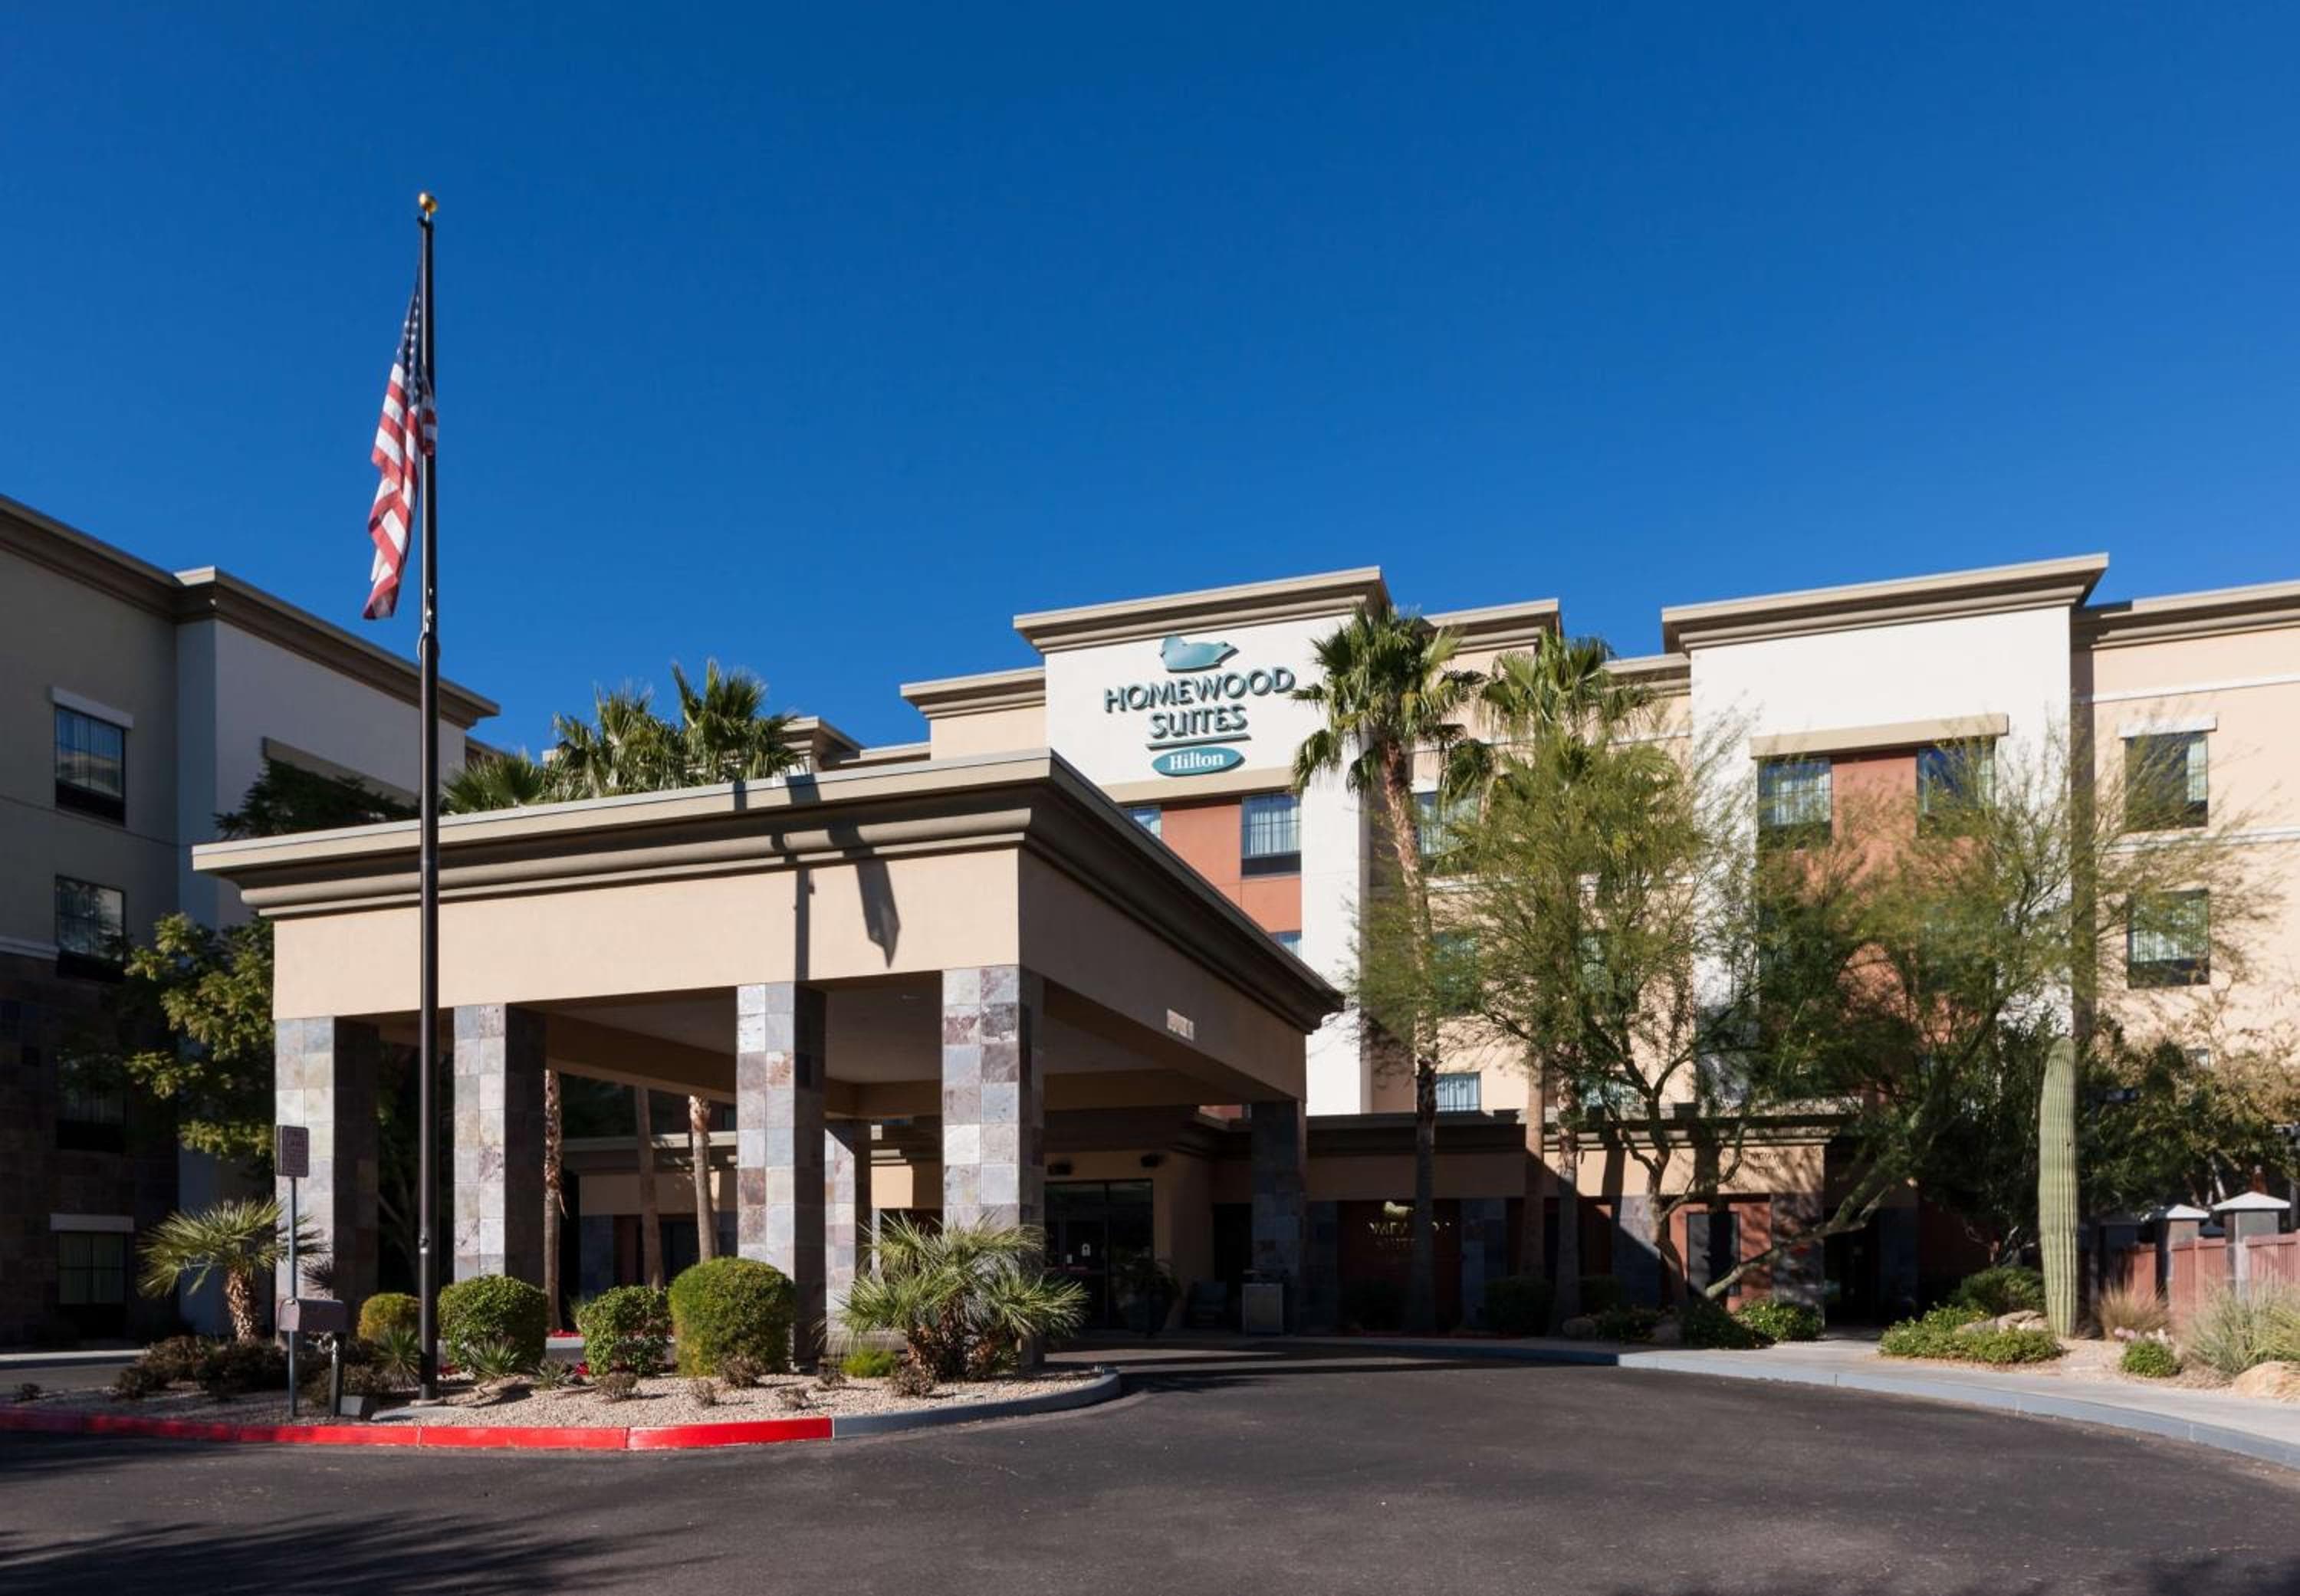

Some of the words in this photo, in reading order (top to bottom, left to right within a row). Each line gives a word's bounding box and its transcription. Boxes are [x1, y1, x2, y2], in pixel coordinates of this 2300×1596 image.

[1104, 667, 1296, 713] HOMEWOOD
[1151, 704, 1248, 738] SUITES
[1169, 753, 1224, 770] Hilton
